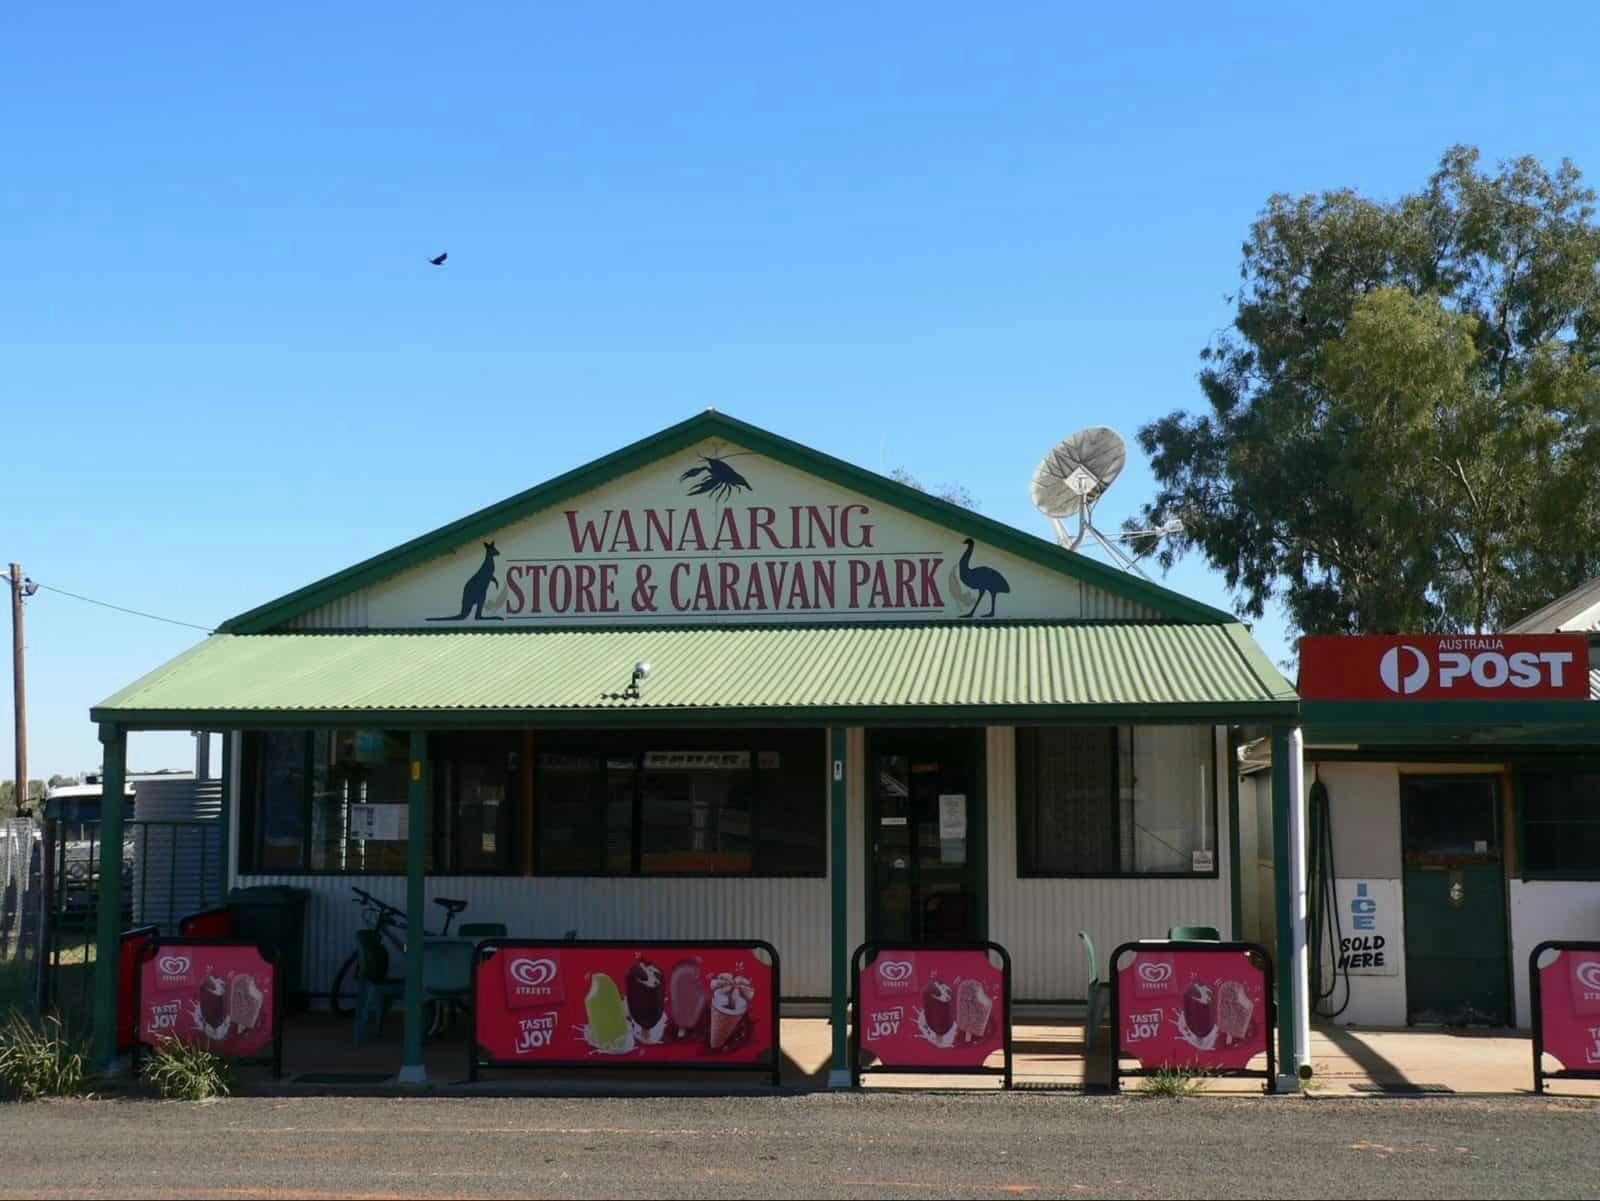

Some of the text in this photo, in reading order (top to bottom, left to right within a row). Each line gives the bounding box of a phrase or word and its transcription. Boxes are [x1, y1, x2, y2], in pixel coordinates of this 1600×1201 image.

[563, 504, 875, 553] WANAARING
[506, 558, 944, 614] STORE & CARAVAN PARK
[1438, 639, 1504, 649] AUSTRALIA
[1438, 652, 1573, 688] POST
[1351, 883, 1376, 930] ICE
[1341, 936, 1385, 952] SOLD
[1338, 952, 1384, 968] HERE
[152, 1014, 178, 1028] JOY
[519, 1018, 552, 1031] TASTE
[871, 1012, 900, 1022] TASTE
[1130, 1014, 1159, 1024] TASTE
[871, 1022, 900, 1036] JOY
[1131, 1024, 1159, 1037] JOY
[520, 1031, 552, 1047] JOY
